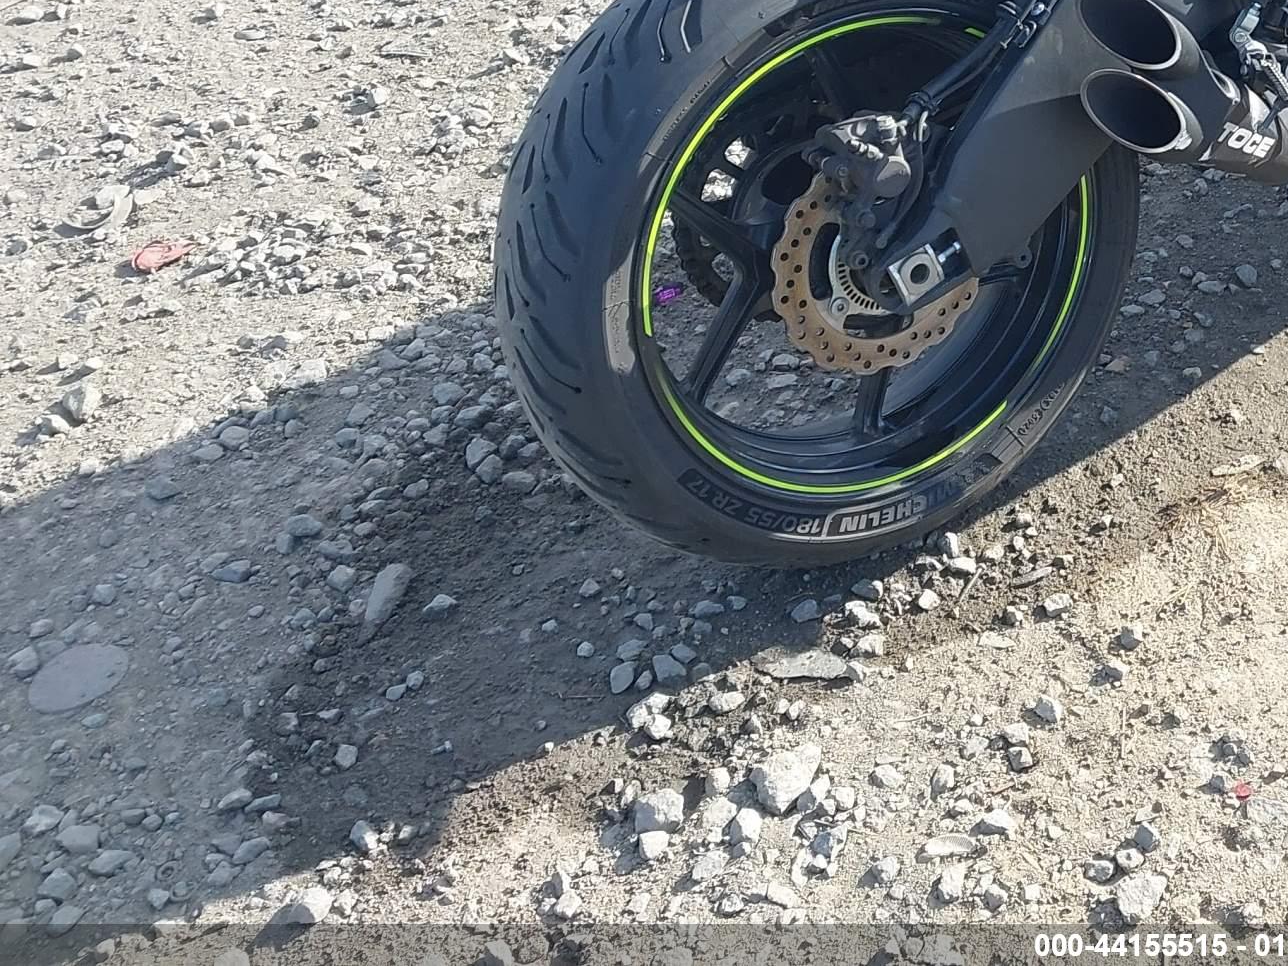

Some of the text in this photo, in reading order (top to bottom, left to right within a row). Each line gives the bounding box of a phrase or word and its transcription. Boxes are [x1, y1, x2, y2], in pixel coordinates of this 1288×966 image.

[1217, 121, 1276, 159] TOCE
[686, 477, 958, 535] MICHELIN 180/55 ZR 17
